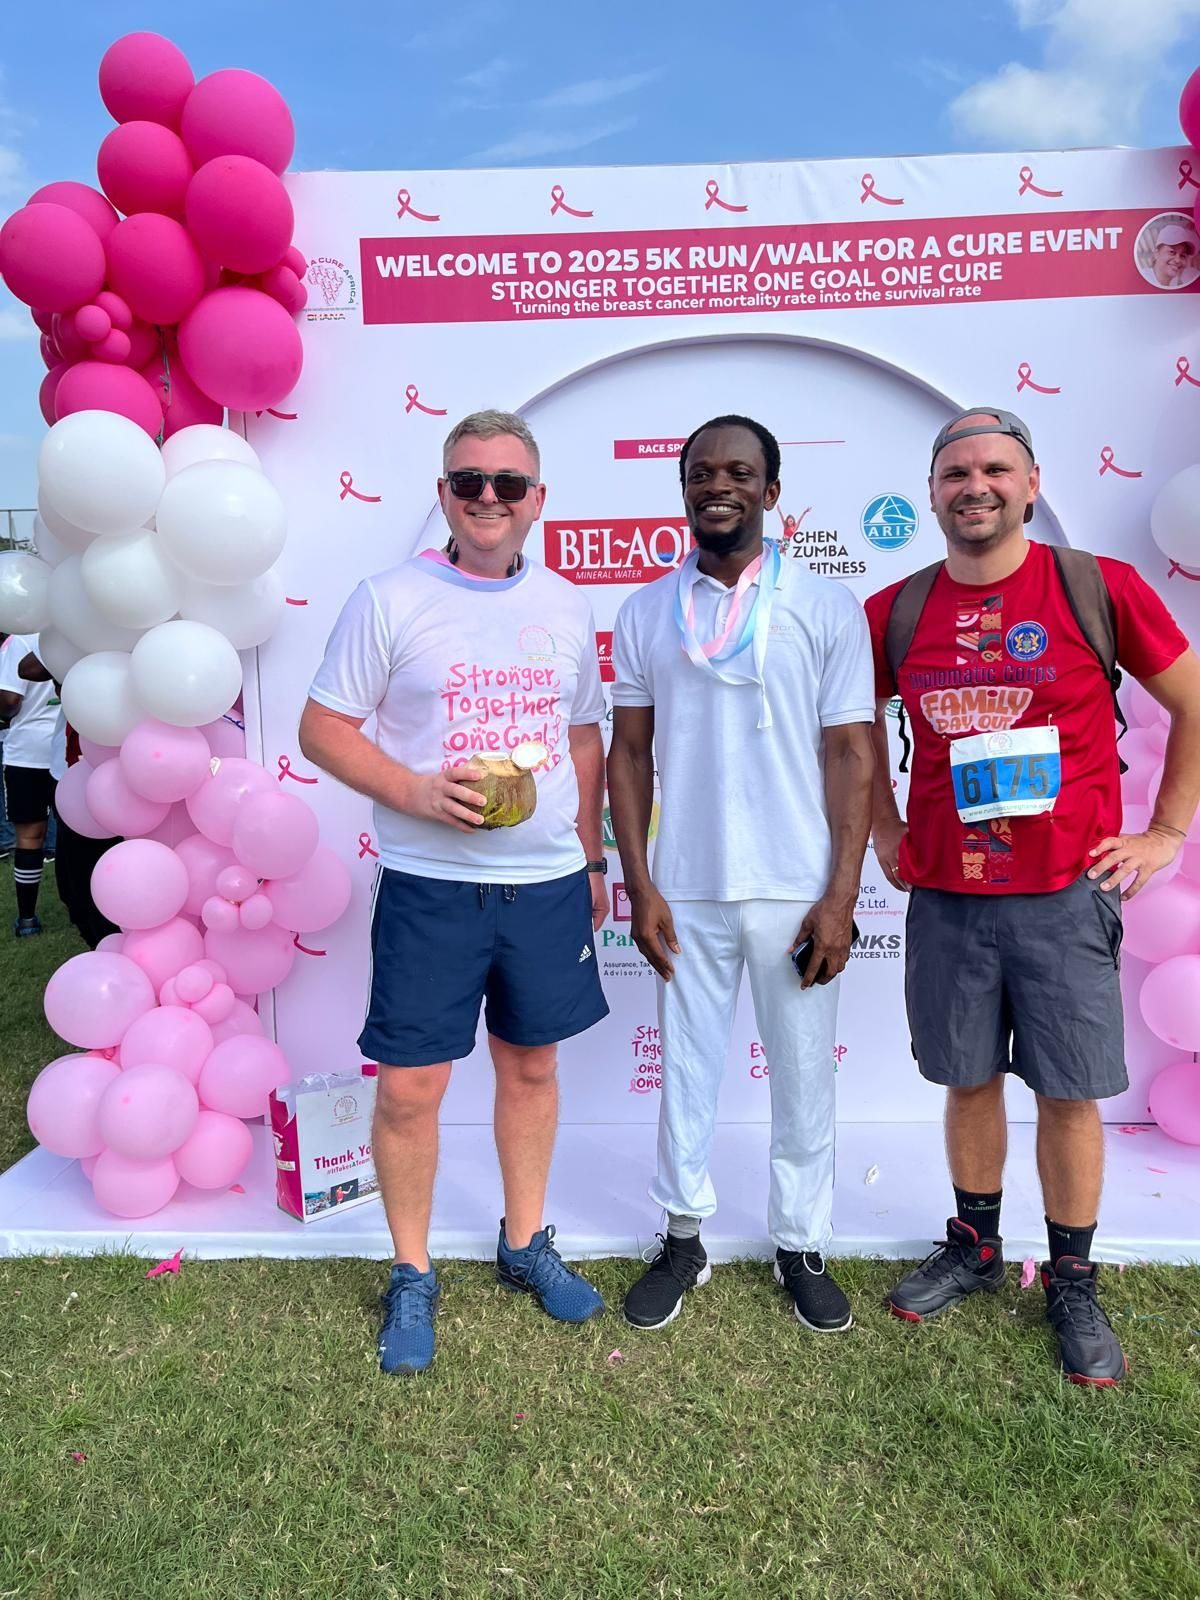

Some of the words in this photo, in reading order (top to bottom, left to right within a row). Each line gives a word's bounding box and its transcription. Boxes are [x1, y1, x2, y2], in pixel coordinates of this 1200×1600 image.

[375, 252, 517, 278] WELCOME
[523, 251, 562, 274] TO
[568, 248, 640, 273] 2025
[646, 247, 683, 271] 5K
[688, 240, 852, 273] RUN/WALK
[858, 237, 915, 262] FOR
[921, 236, 942, 259] A
[947, 232, 1023, 258] CURE
[1030, 227, 1123, 254] EVENT
[318, 257, 344, 270] CURE
[343, 269, 356, 304] AFRICA
[491, 278, 618, 301] STRONGER
[622, 273, 748, 297] TOGETHER
[753, 271, 805, 292] ONE
[810, 268, 876, 290] GOAL
[881, 264, 933, 287] ONE
[938, 261, 1003, 284] CURE
[512, 300, 570, 316] Turning
[574, 299, 600, 313] the
[603, 297, 652, 312] breast
[655, 298, 706, 310] cancer
[708, 292, 781, 309] mortality
[784, 292, 817, 305] rate
[819, 289, 851, 303] into
[854, 287, 881, 302] the
[884, 285, 945, 301] survival
[949, 284, 982, 298] rate
[638, 444, 665, 453] RACE
[793, 530, 838, 544] CHEN
[868, 525, 913, 537] ARIS
[793, 545, 849, 558] ZUMBA
[576, 570, 612, 580] MINERAL
[614, 569, 642, 579] WATER
[449, 662, 555, 694] Stronger
[909, 666, 996, 690] Diplomatic
[1003, 664, 1057, 685] Corps
[440, 691, 561, 725] Together
[935, 715, 973, 732] DAY
[978, 714, 1013, 730] OUT
[449, 730, 500, 752] one
[961, 755, 1050, 805] 6175
[868, 898, 889, 909] Ltd.
[883, 951, 900, 959] LTD
[603, 961, 639, 969] Assurance,
[603, 969, 643, 977] Advisory
[313, 1149, 354, 1170] Thank
